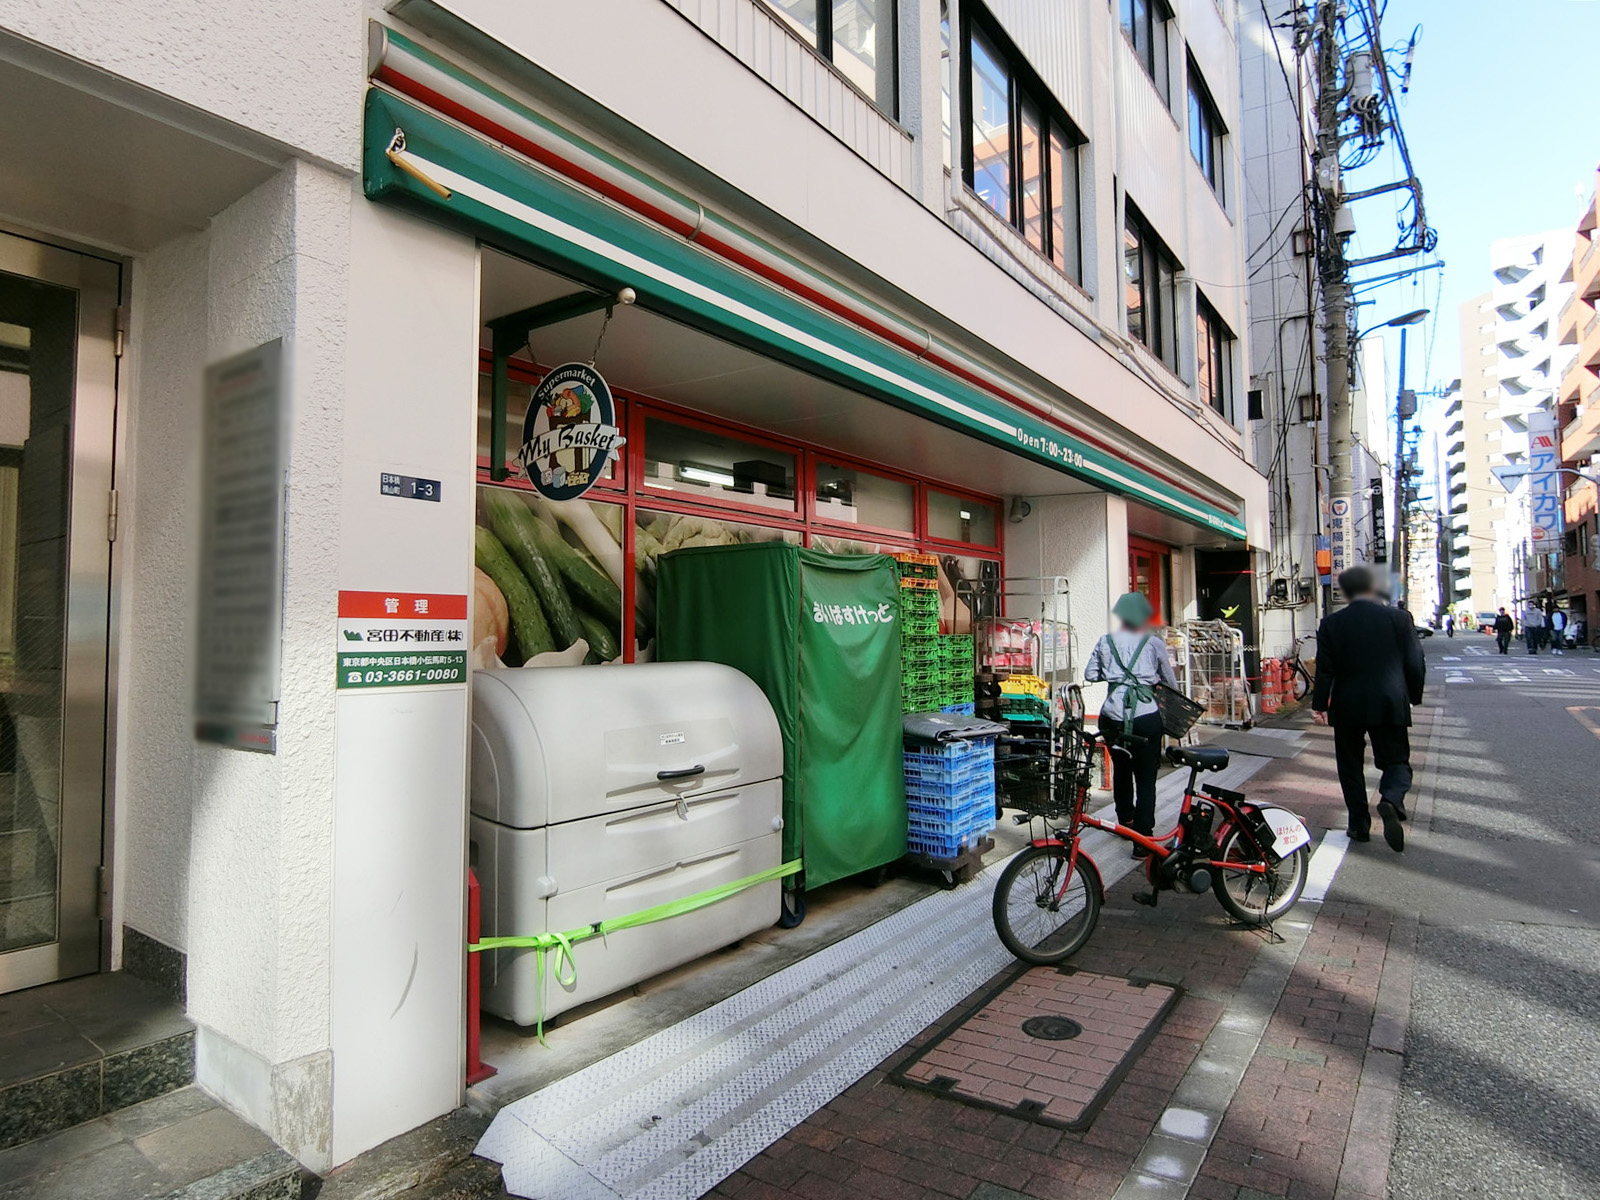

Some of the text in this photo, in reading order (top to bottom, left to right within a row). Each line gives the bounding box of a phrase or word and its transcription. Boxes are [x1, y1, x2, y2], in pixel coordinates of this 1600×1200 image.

[538, 369, 596, 399] Supermarket
[518, 423, 616, 467] My Basket
[1017, 427, 1040, 449] Open
[411, 482, 434, 497] 1-3
[1531, 453, 1557, 530] アイカワ
[365, 668, 459, 683] 03-3661-0080
